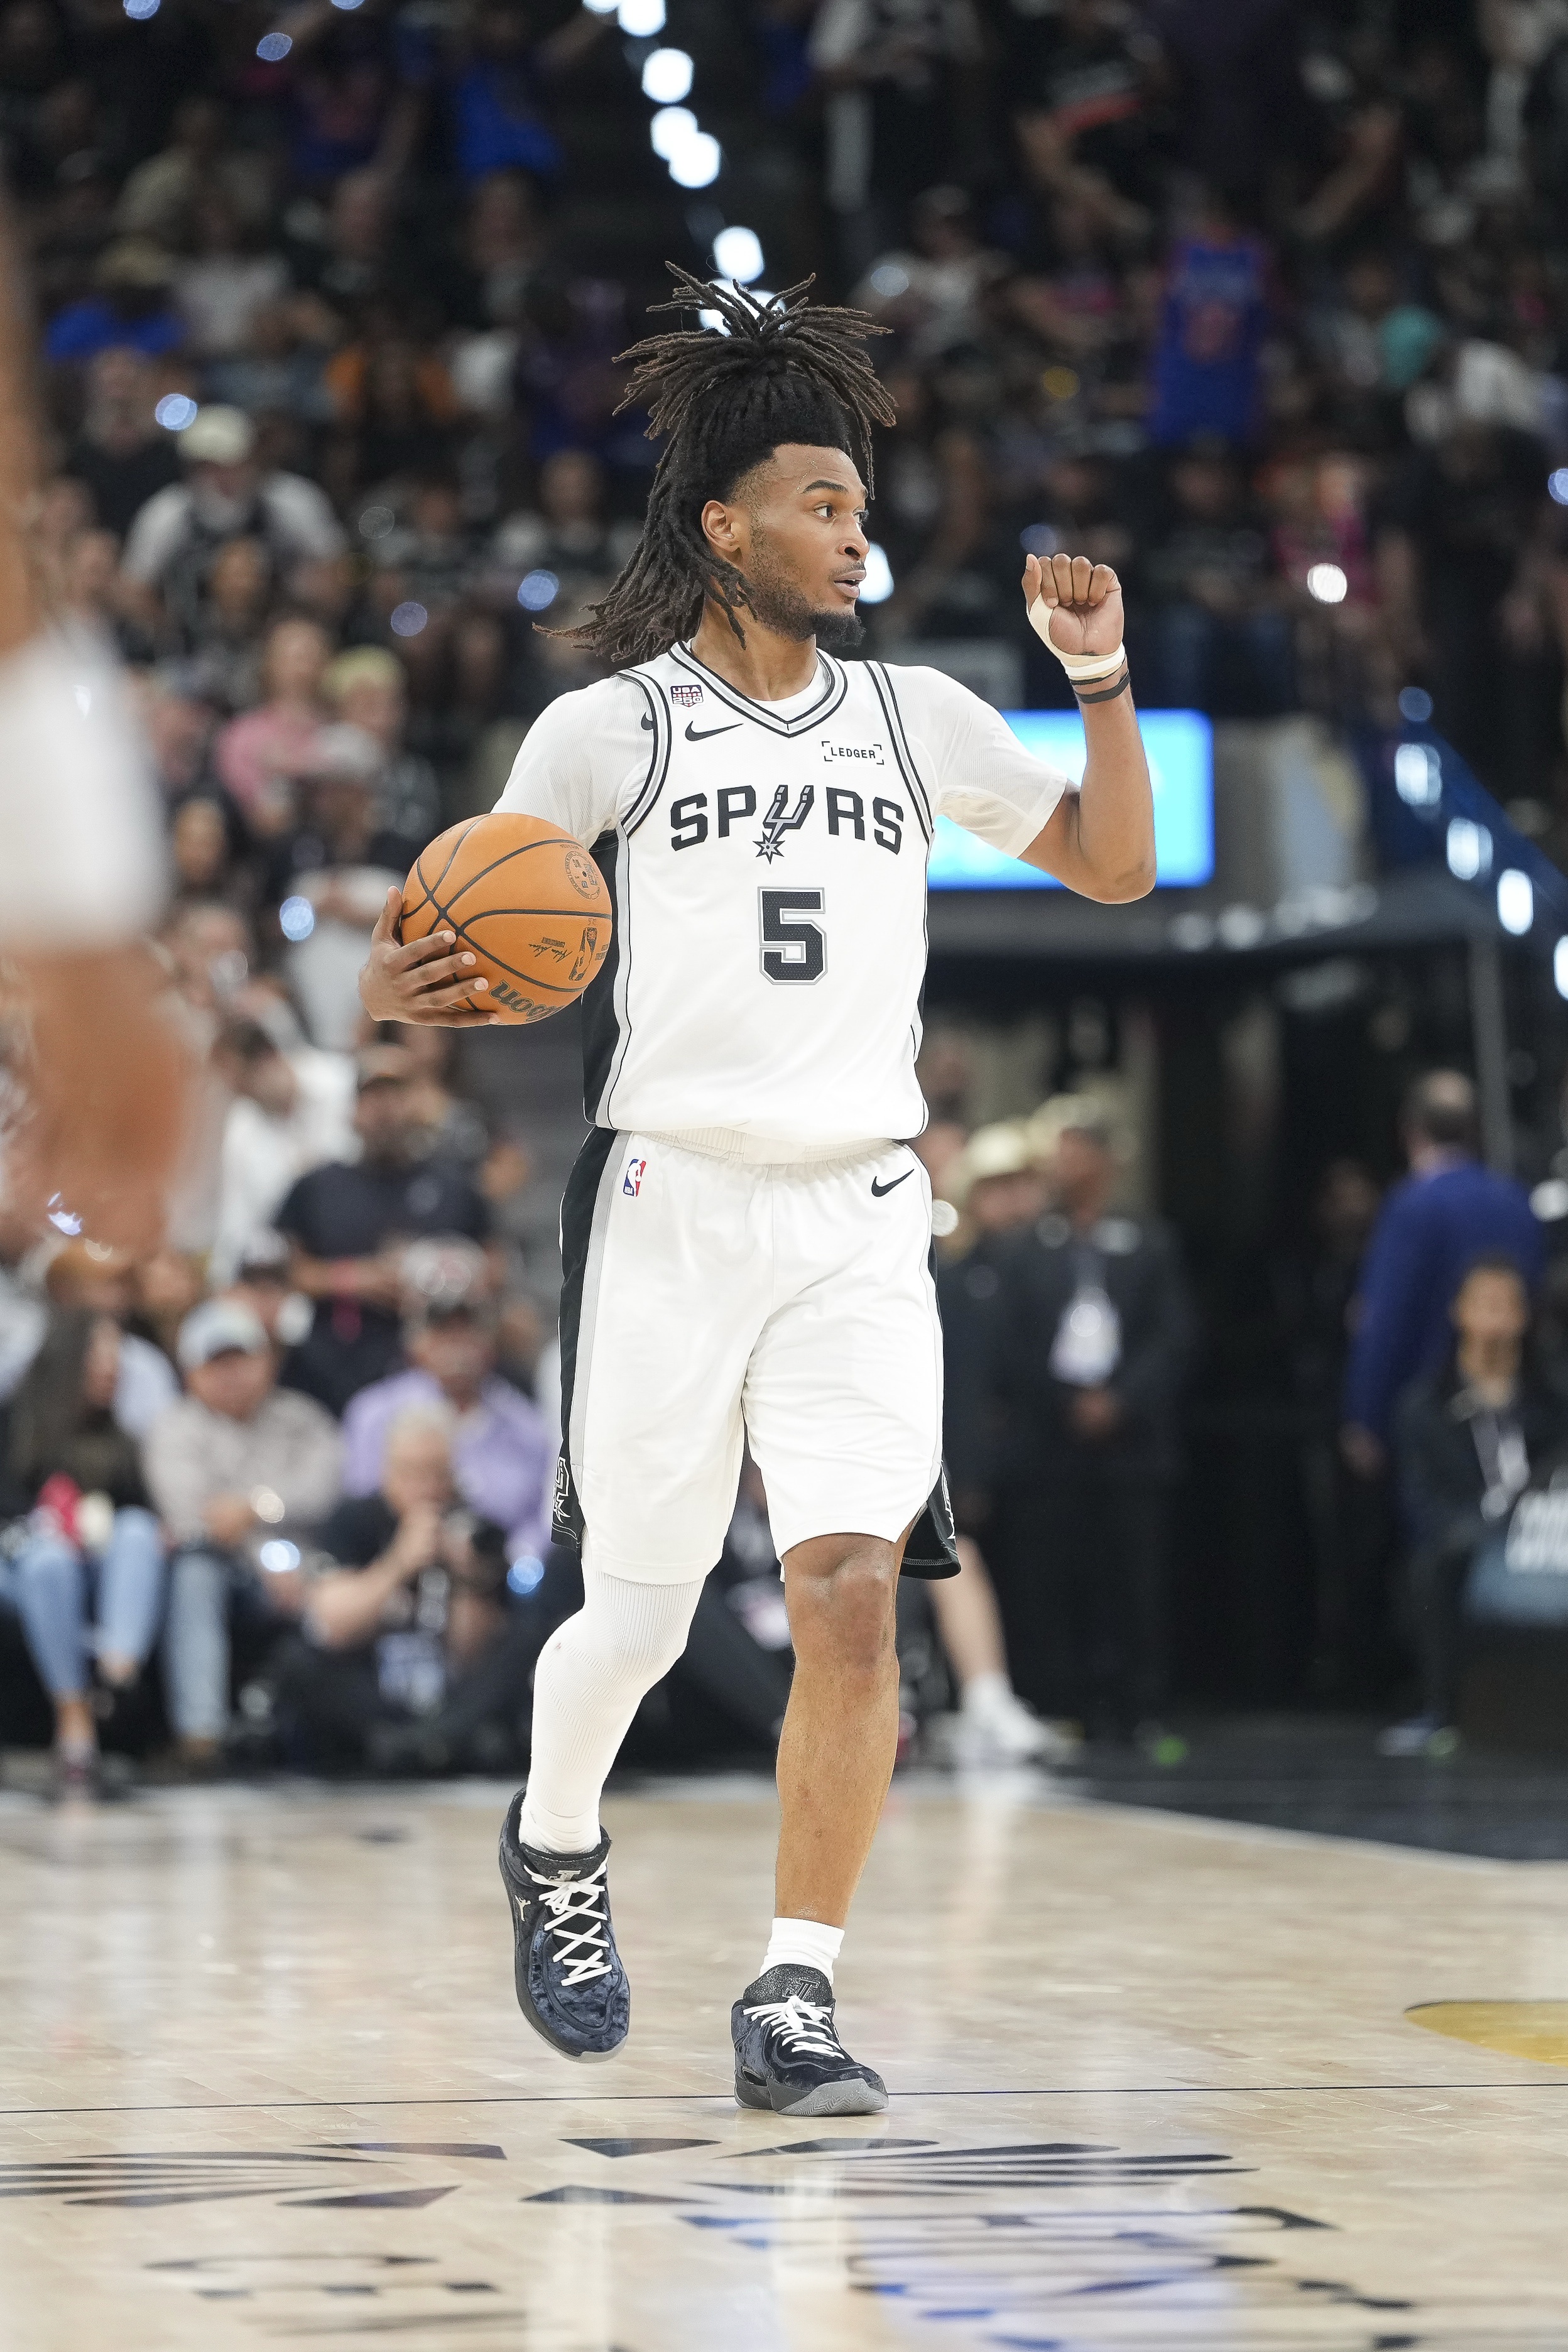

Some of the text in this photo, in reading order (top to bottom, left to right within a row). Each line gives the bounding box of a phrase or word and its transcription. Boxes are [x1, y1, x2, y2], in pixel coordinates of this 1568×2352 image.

[830, 747, 876, 759] LEDGER
[670, 785, 904, 864] SPURS
[757, 886, 828, 986] 5
